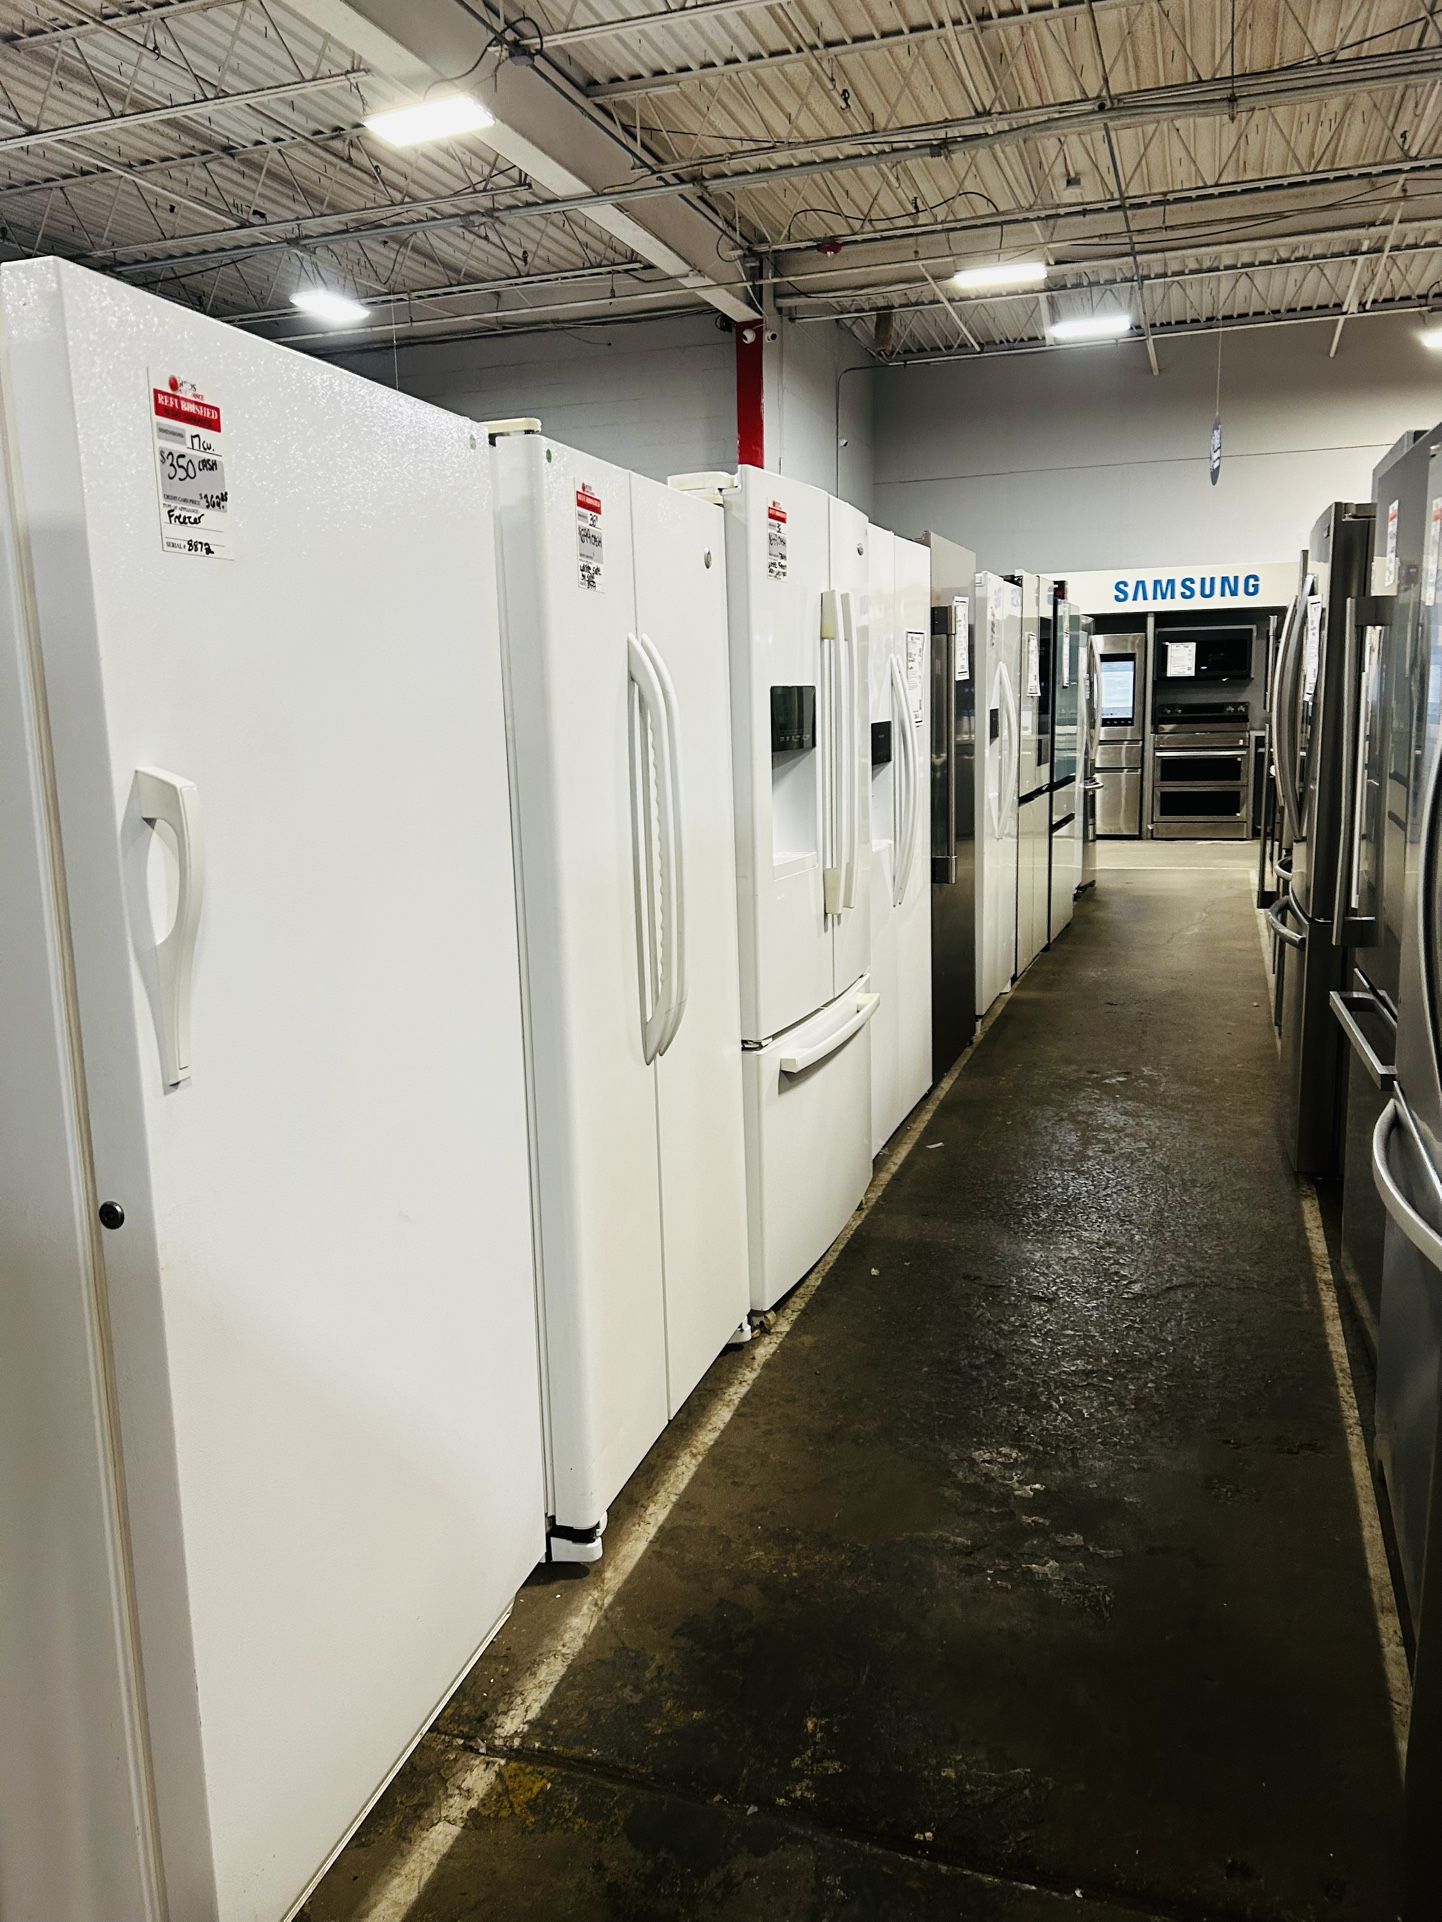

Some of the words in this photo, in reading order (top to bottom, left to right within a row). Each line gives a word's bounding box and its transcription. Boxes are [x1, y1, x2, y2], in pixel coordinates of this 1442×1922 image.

[157, 393, 218, 420] REFURBISHED
[159, 450, 197, 481] $350
[198, 458, 218, 471] CASH
[187, 539, 215, 555] 8872
[1114, 574, 1260, 603] SAMSUNG
